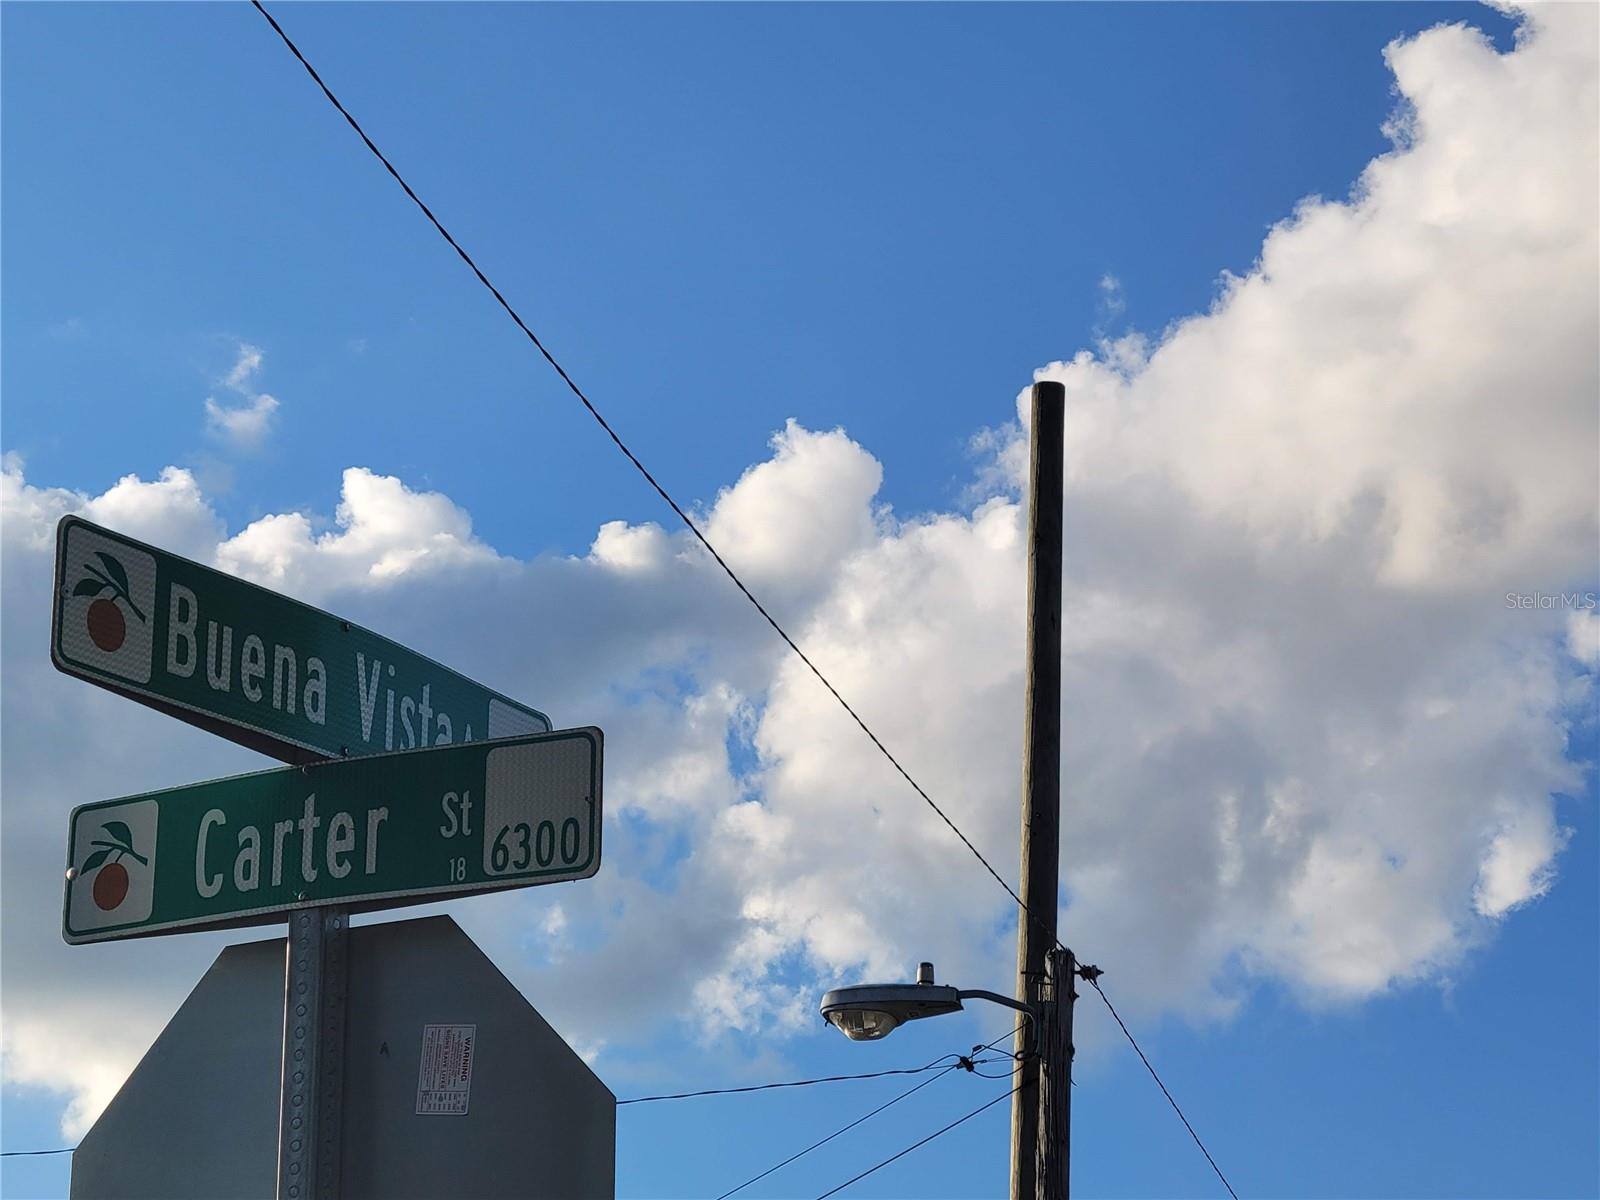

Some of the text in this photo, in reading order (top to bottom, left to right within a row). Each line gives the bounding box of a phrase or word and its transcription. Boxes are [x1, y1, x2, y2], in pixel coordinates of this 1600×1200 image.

[167, 583, 453, 751] Buena Vista
[196, 790, 473, 898] Carter St
[449, 857, 466, 882] 18
[491, 817, 580, 872] 6300
[460, 1037, 471, 1082] WARNING
